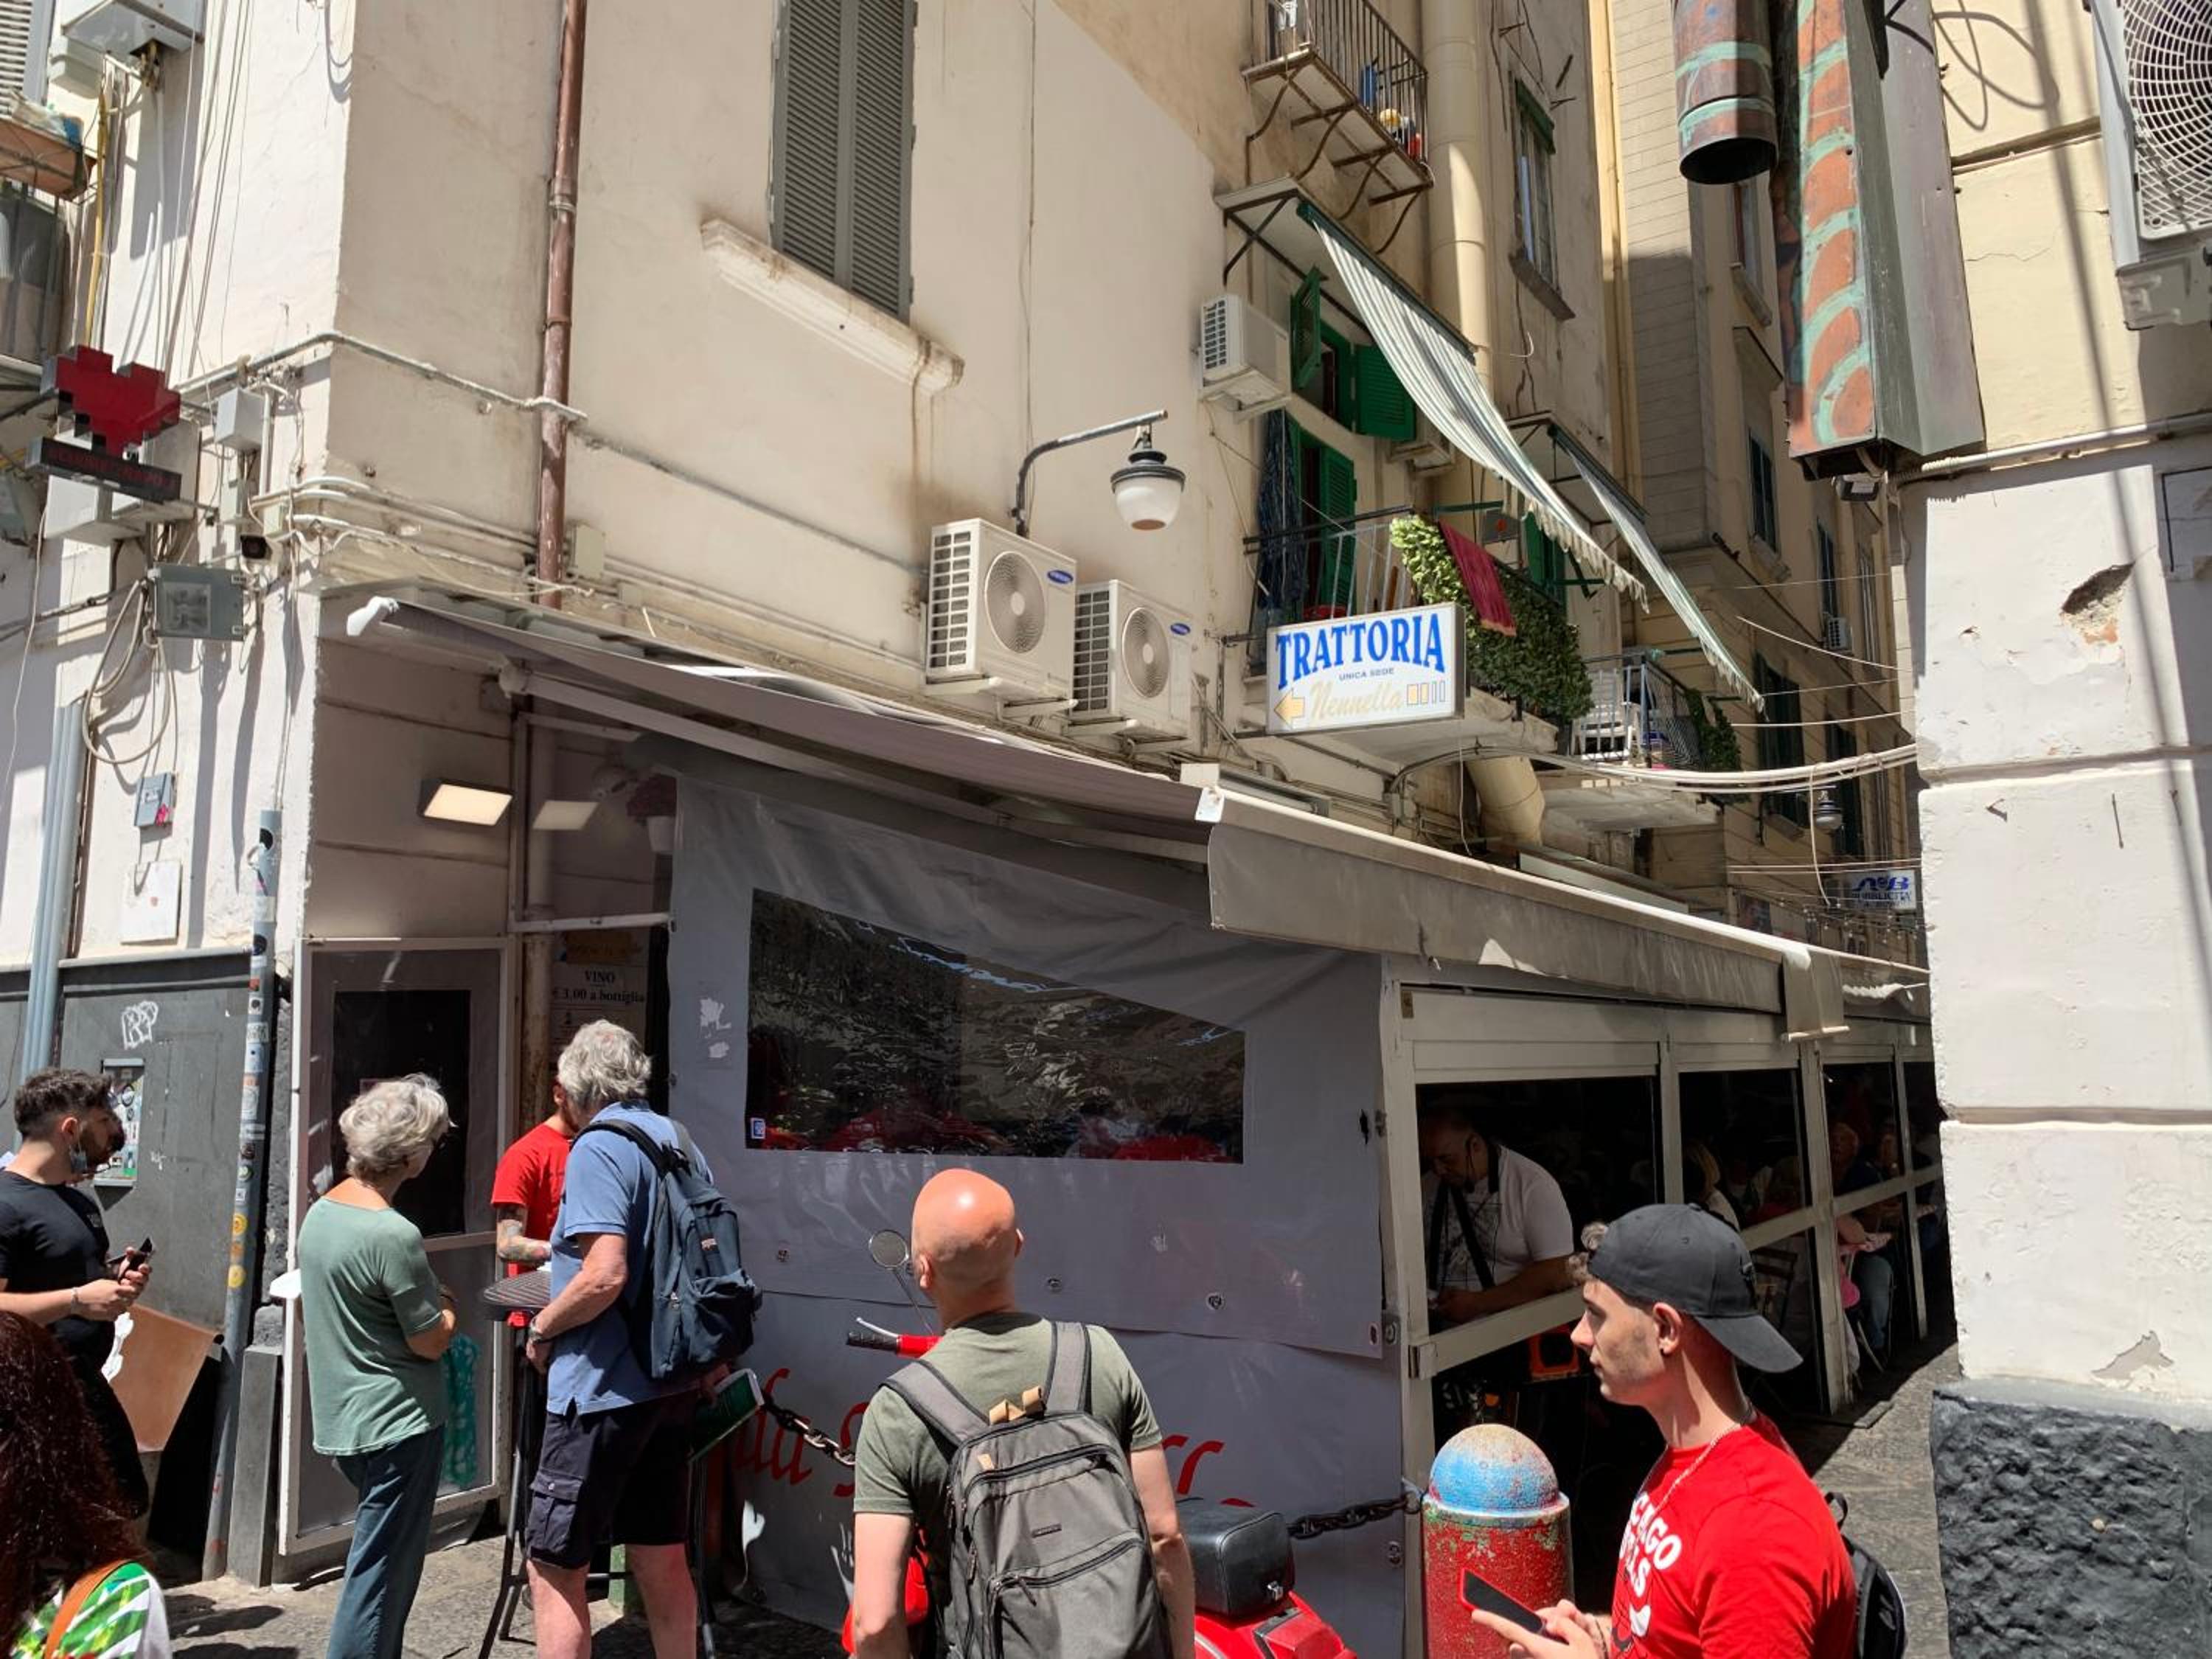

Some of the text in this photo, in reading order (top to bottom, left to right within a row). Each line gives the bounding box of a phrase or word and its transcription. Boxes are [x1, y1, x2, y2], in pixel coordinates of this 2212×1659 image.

[1276, 613, 1445, 691] TRATTORIA
[1338, 667, 1394, 681] UNICA SEDE
[1310, 679, 1402, 720] Nennella
[585, 970, 616, 984] VINO
[600, 989, 645, 1006] bottiglia
